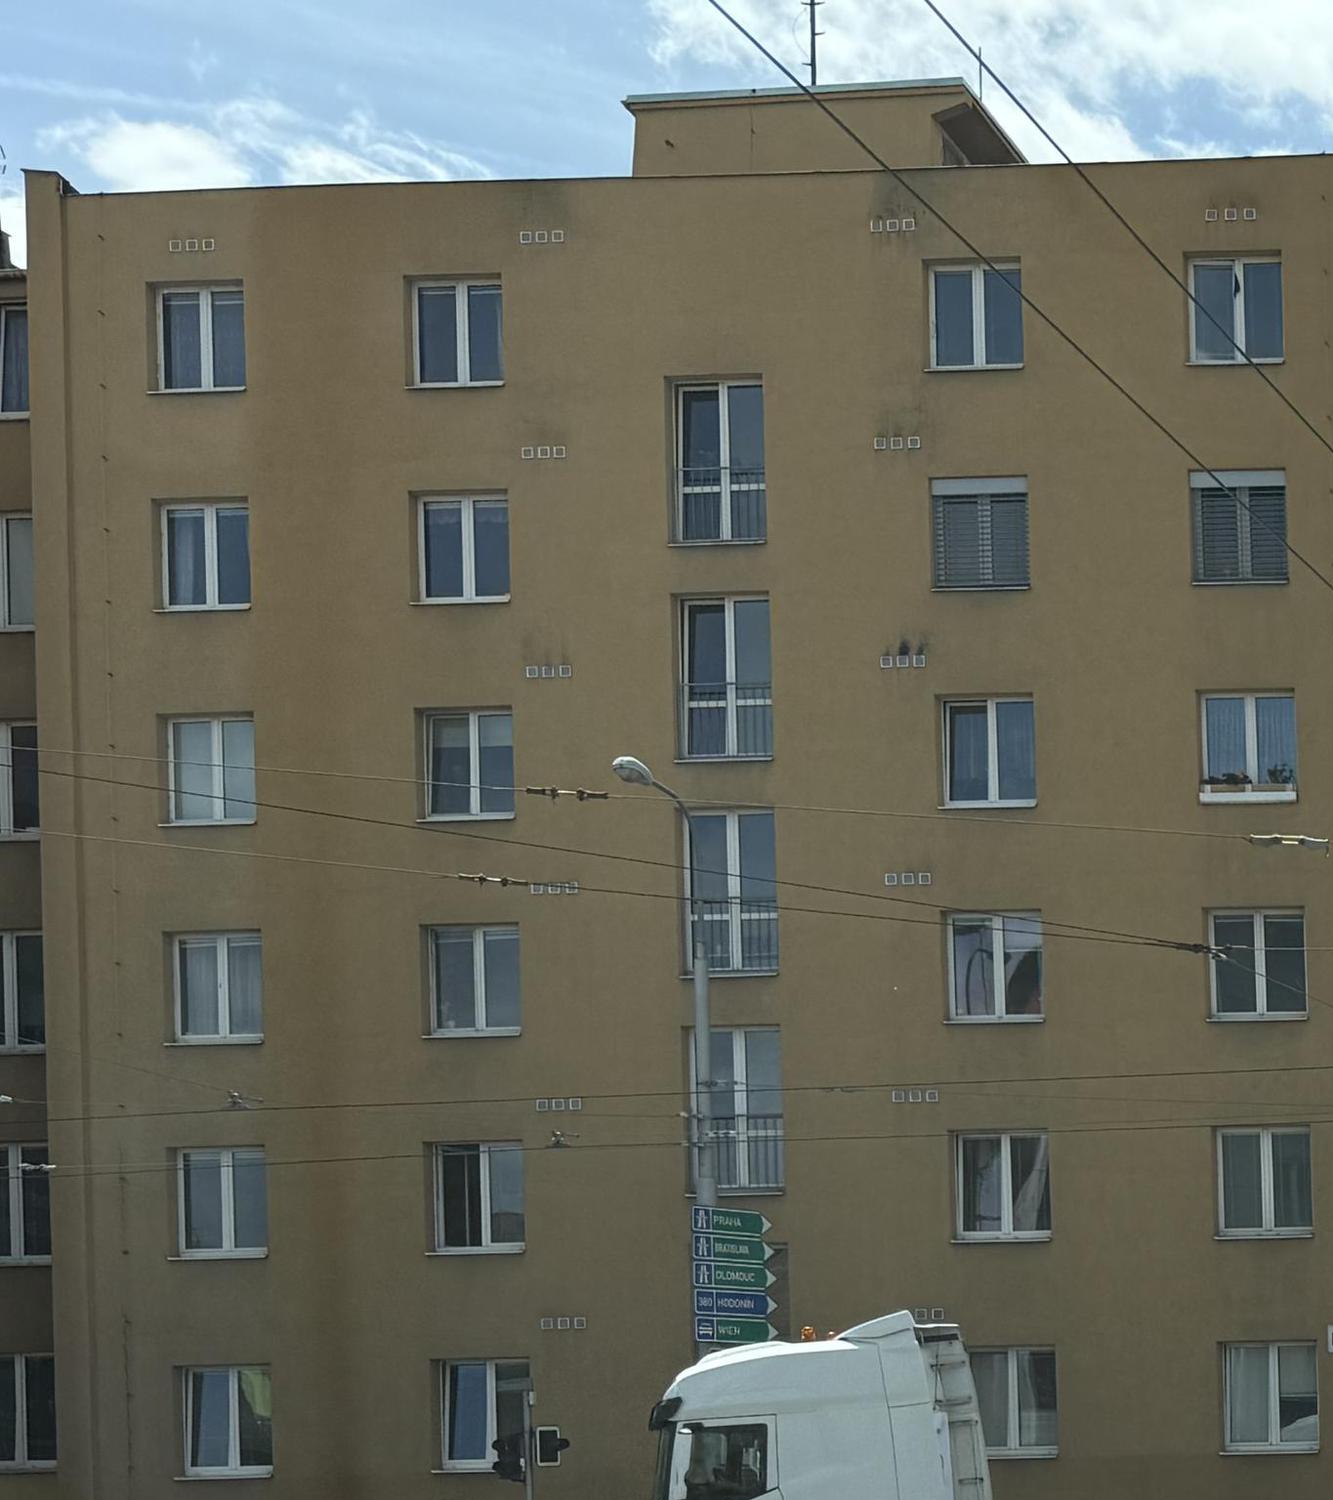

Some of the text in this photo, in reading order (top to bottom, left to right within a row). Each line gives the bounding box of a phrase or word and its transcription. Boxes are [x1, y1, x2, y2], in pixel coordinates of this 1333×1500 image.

[713, 1216, 743, 1228] PRAHA
[715, 1270, 756, 1282] OLOMOUC
[718, 1324, 741, 1336] WIEN
